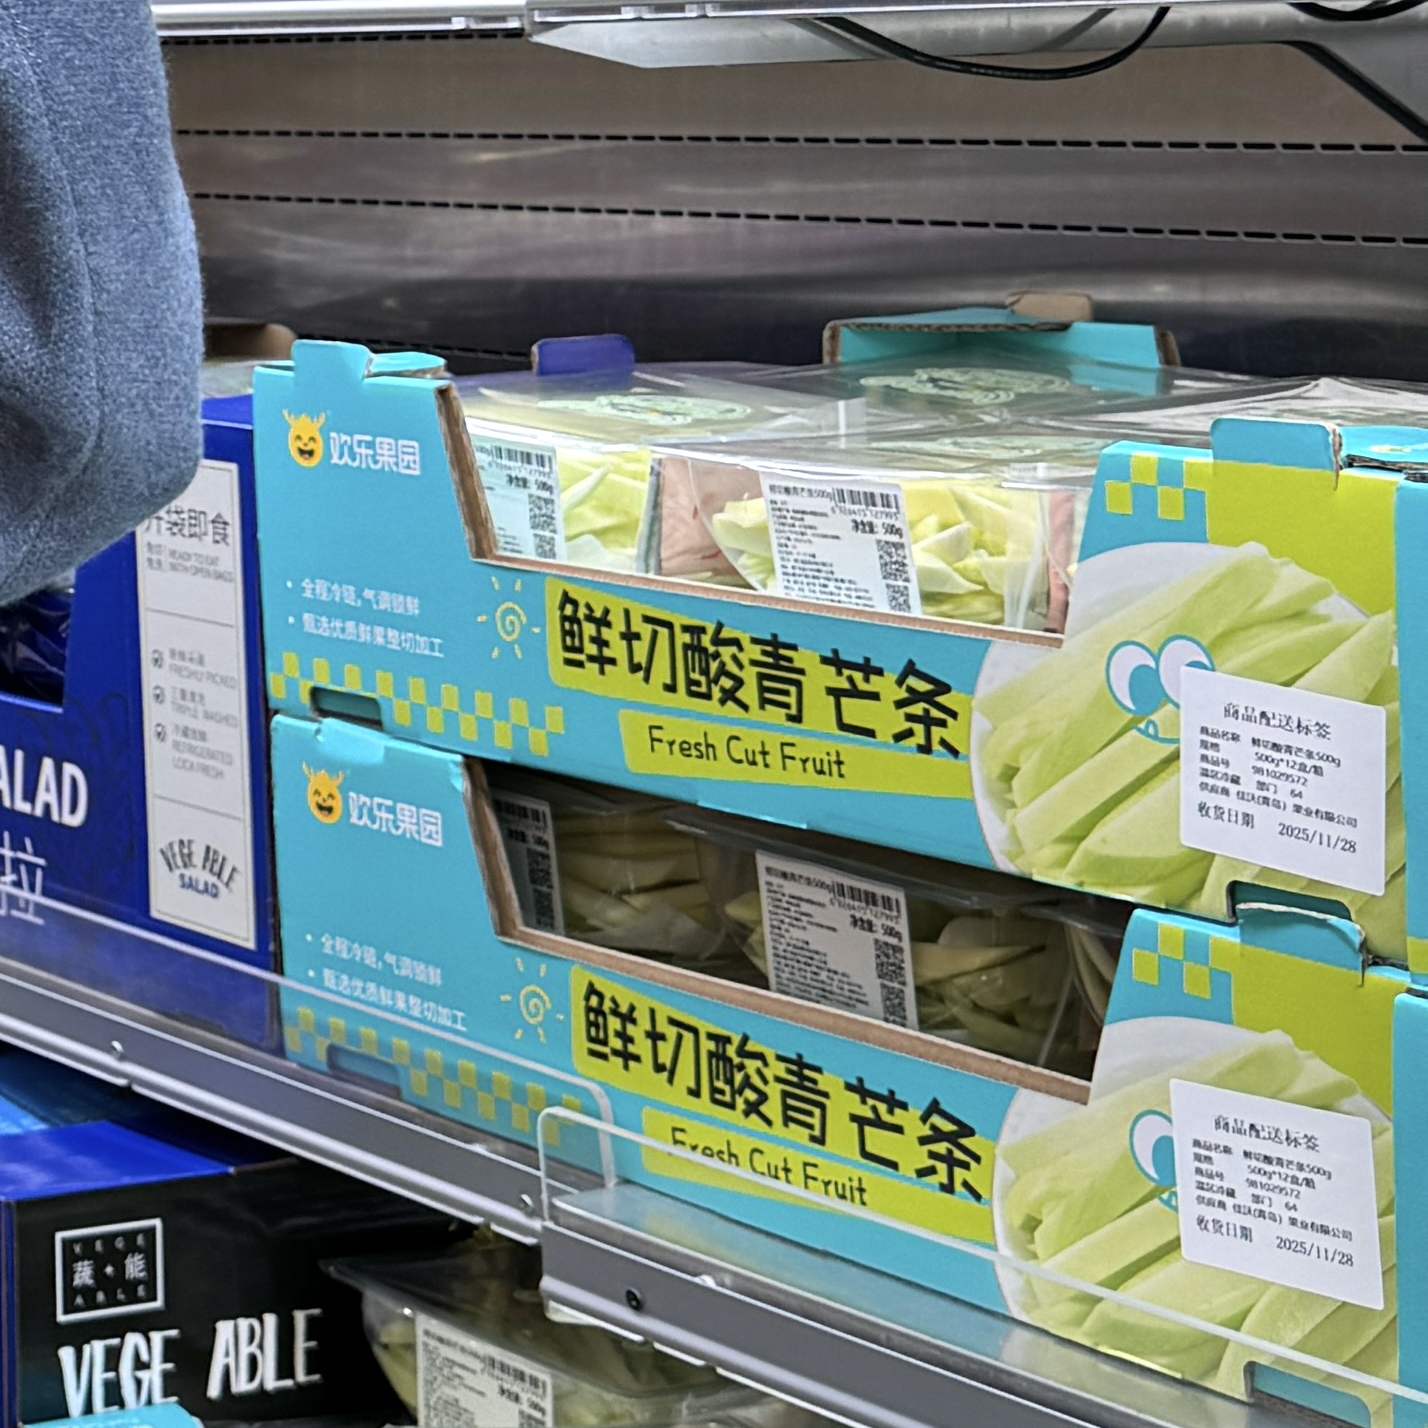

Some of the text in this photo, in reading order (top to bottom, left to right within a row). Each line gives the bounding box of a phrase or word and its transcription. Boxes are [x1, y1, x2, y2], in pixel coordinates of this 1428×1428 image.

[329, 430, 421, 477] 欢乐果园
[882, 522, 904, 539] 500g
[556, 588, 962, 760] 鲜切酸青芒条
[1224, 702, 1331, 740] 商品配送标签
[647, 724, 847, 779] Fresh Cut Fruit
[349, 791, 443, 848] 欢乐果园
[1198, 800, 1357, 853] 收货日期 2025/11/28
[179, 873, 219, 898] SALAD
[582, 980, 983, 1203] 鲜切酸青芒条
[1214, 1114, 1320, 1153] 商品配送标签
[671, 1127, 868, 1207] Fresh Cut Fruit
[1196, 1214, 1354, 1268] 收货日期 2025/11/28
[57, 1328, 182, 1419] VEGE
[206, 1308, 324, 1401] ABLE
